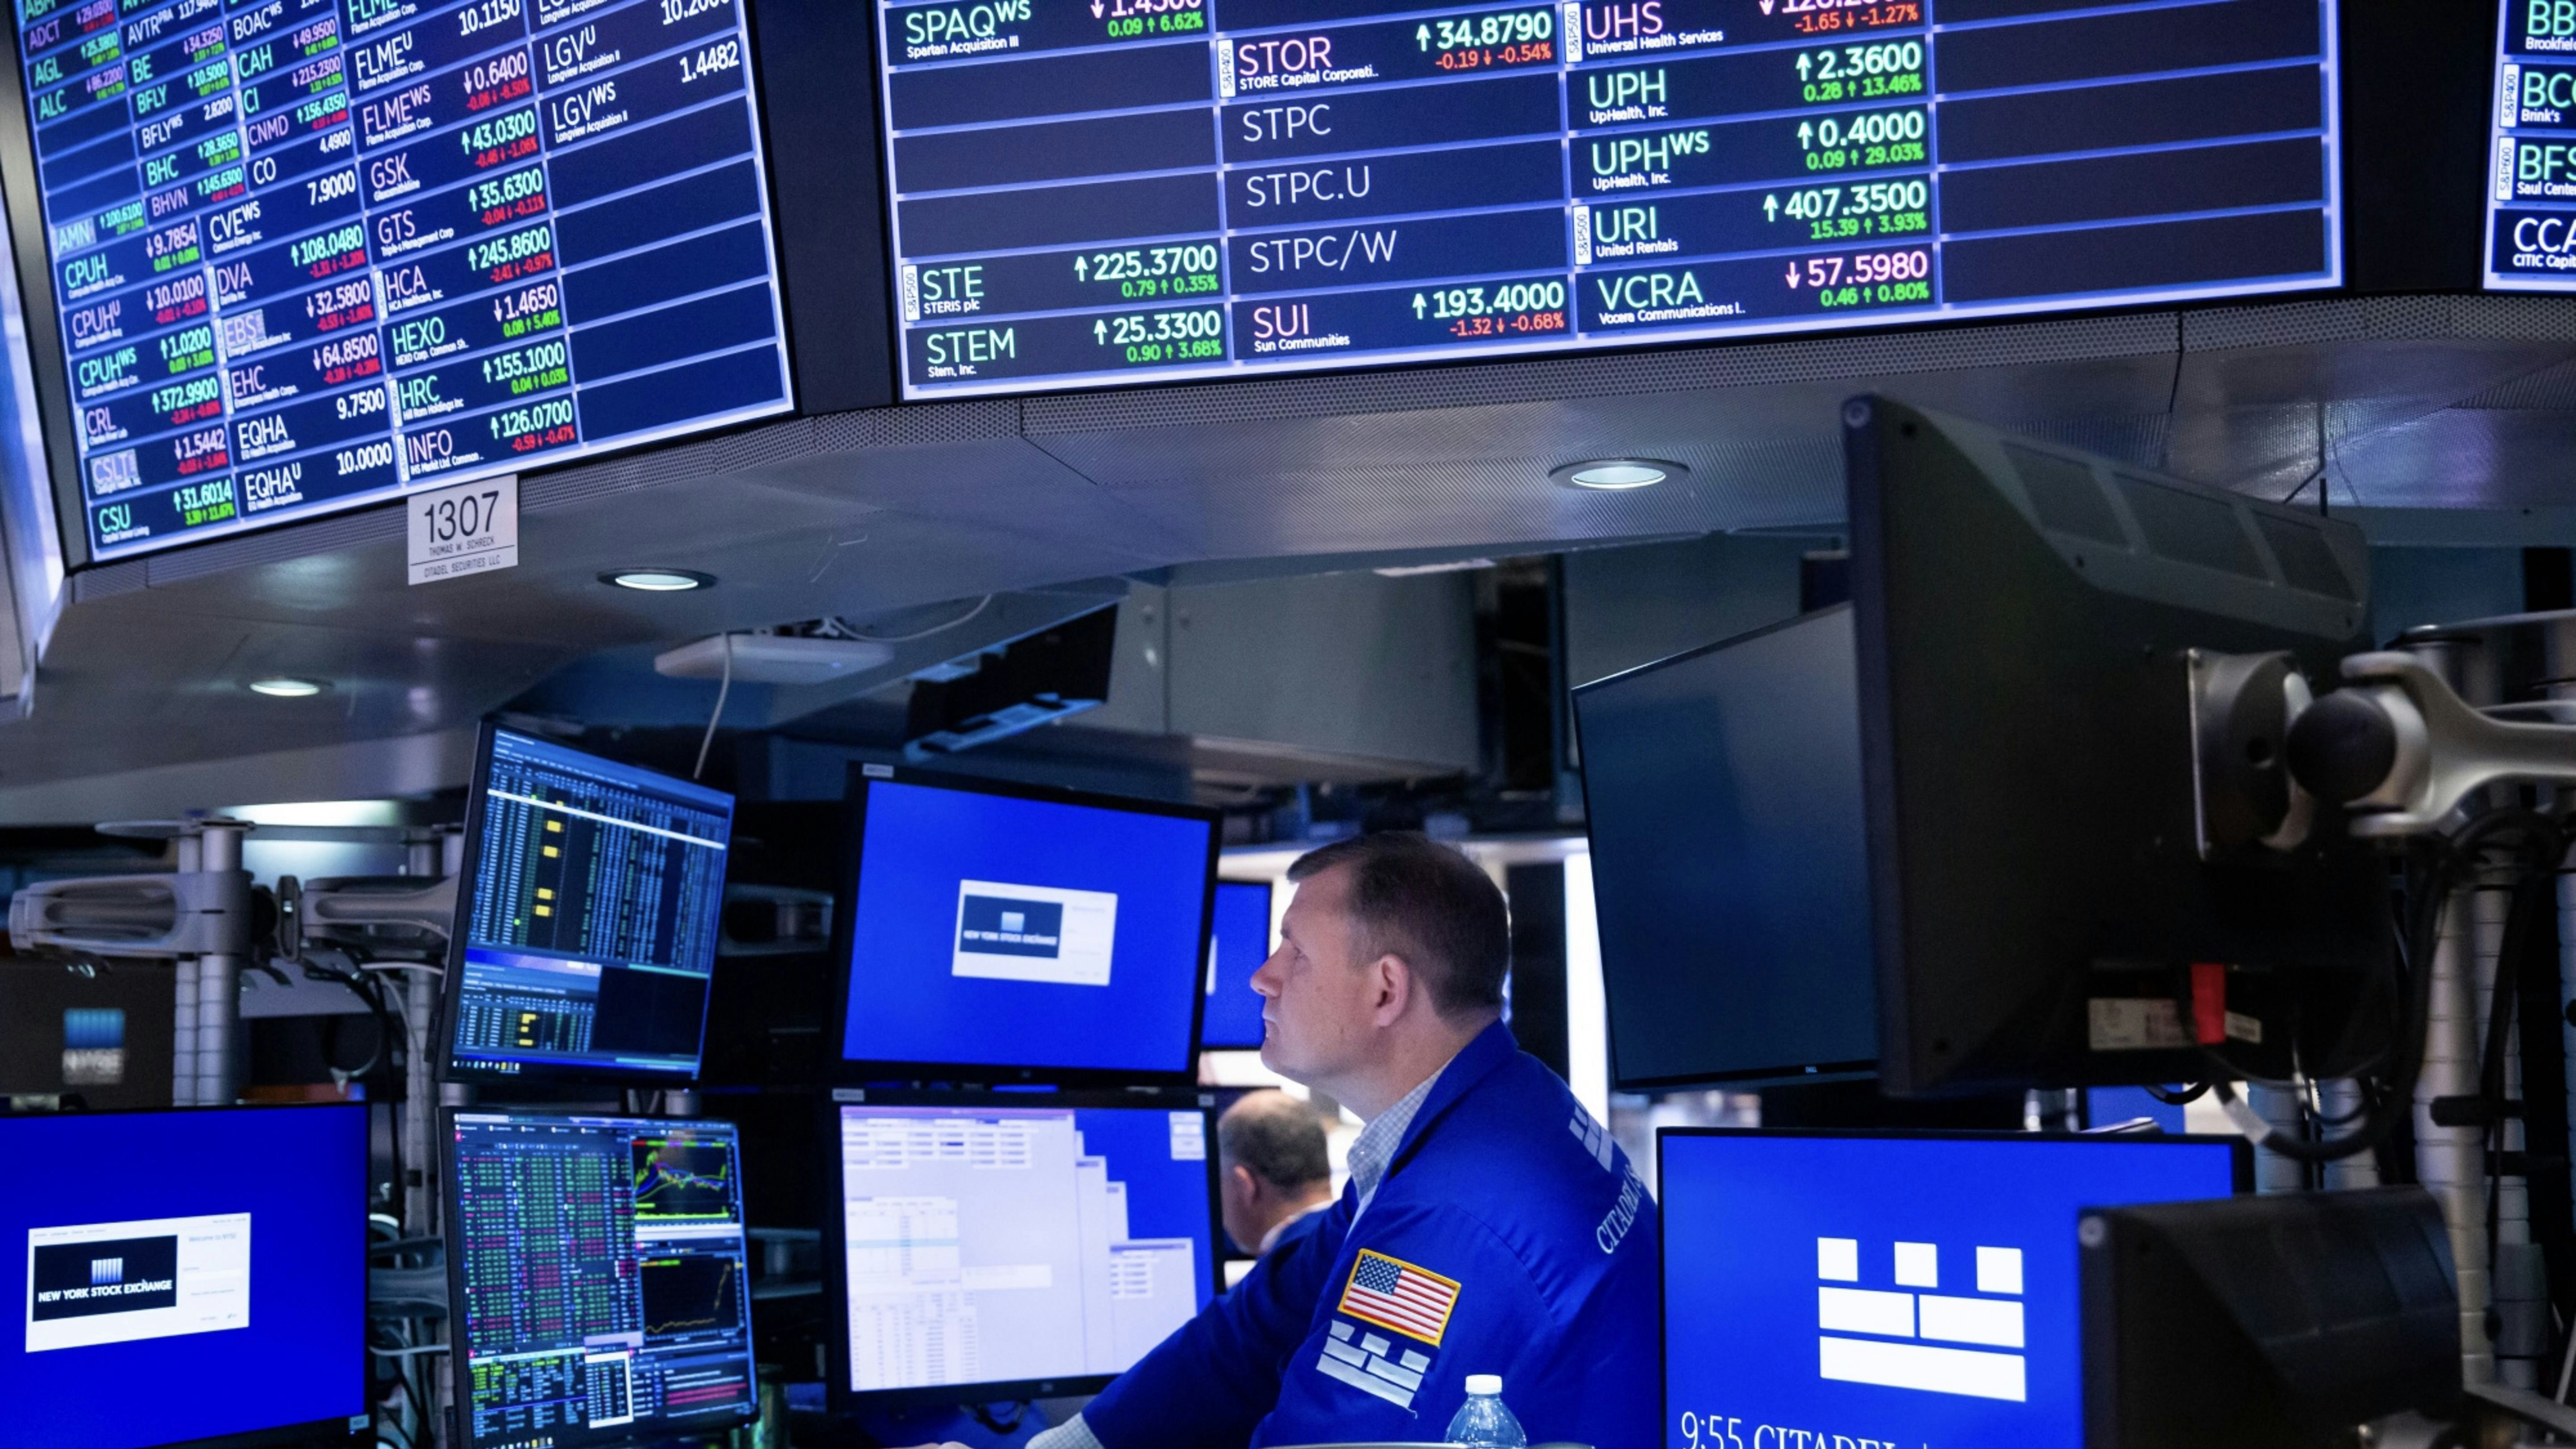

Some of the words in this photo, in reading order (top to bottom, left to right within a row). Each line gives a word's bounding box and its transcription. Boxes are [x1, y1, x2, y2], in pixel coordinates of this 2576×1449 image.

[458, 0, 520, 36] 10.1150
[1108, 20, 1143, 37] 0.09
[1160, 11, 1203, 32] 6.62%
[1436, 11, 1551, 50] 34.8790
[1585, 1, 1663, 40] UHS
[1795, 14, 1840, 33] -1.65
[1861, 4, 1919, 25] -1.27%
[907, 42, 947, 59] Spartan
[949, 37, 1007, 55] Acquisition
[1238, 37, 1333, 77] STOR
[1435, 50, 1479, 70] -0.19
[1497, 42, 1551, 63] -0.54%
[1586, 36, 1638, 56] Universal
[1640, 32, 1676, 51] Health
[1679, 30, 1724, 47] Services
[35, 56, 63, 87] AGL
[131, 54, 153, 84] BE
[238, 43, 273, 78] CAH
[474, 51, 527, 90] 0.6400
[680, 41, 740, 83] 1.4482
[1817, 42, 1922, 81] 2.3600
[1240, 74, 1278, 90] STORE
[1281, 70, 1319, 88] Capital
[1589, 68, 1667, 110] UPH
[1804, 81, 1843, 102] 0.28
[1862, 73, 1922, 97] 13.46%
[2523, 72, 2576, 108] BC
[39, 89, 67, 120] ALC
[136, 84, 167, 114] BFLY
[243, 87, 259, 113] CI
[1590, 106, 1646, 125] UpHealth,
[1648, 105, 1669, 119] Inc.
[2521, 108, 2561, 123] Brink's
[248, 114, 288, 146] CNMD
[472, 110, 535, 149] 43.0300
[1242, 104, 1332, 143] STPC
[1818, 111, 1924, 149] 0.4000
[319, 129, 351, 155] 4.4900
[1807, 149, 1845, 170] 0.09
[1865, 142, 1924, 166] 29.03%
[253, 157, 276, 185] CO
[307, 170, 356, 205] 7.9000
[371, 153, 411, 188] GSK
[1246, 165, 1370, 207] STPC.U
[1593, 174, 1650, 192] UpHealth,
[1651, 172, 1671, 187] Inc.
[479, 168, 543, 208] 35.6300
[1784, 180, 1926, 220] 407.3500
[2517, 181, 2542, 195] Saul
[154, 222, 198, 255] 9.7854
[378, 210, 415, 244] GTS
[1595, 206, 1658, 244] URI
[1810, 218, 1859, 240] 15.39
[1878, 212, 1927, 234] 3.93%
[301, 225, 363, 265] 108.0480
[479, 226, 550, 268] 245.8600
[1250, 229, 1397, 272] STPC/W
[1596, 242, 1634, 259] United
[1636, 239, 1678, 255] Rentals
[2512, 254, 2544, 267] CITIC
[65, 253, 108, 288] CPUH
[217, 262, 253, 294] DVA
[1093, 244, 1218, 281] 225.3700
[1808, 250, 1928, 287] 57.5980
[315, 280, 370, 314] 32.5800
[385, 265, 427, 301] HCA
[923, 265, 984, 301] STE
[1122, 279, 1157, 298] 0.79
[1173, 274, 1218, 294] 0.35%
[1597, 272, 1703, 310] VCRA
[1821, 286, 1858, 306] 0.46
[1878, 281, 1930, 302] 0.80%
[504, 284, 558, 319] 1.4650
[924, 300, 962, 314] STERIS
[963, 297, 980, 312] plc
[1432, 282, 1565, 319] 193.4000
[1599, 309, 1635, 326] Vocera
[1637, 302, 1733, 322] Communications
[392, 316, 445, 354] HEXO
[1112, 310, 1221, 344] 25.3300
[1254, 303, 1309, 338] SUI
[1450, 318, 1491, 337] -1.32
[1511, 312, 1565, 332] -0.68%
[323, 333, 377, 368] 64.8500
[927, 327, 1016, 364] STEM
[1126, 344, 1161, 363] 0.90
[1178, 339, 1222, 357] 3.68%
[1254, 338, 1276, 352] Sun
[1279, 332, 1350, 351] Communities
[494, 341, 565, 381] 155.1000
[928, 364, 957, 378] Stem,
[959, 362, 977, 376] Inc.
[161, 377, 219, 412] 372.9900
[231, 365, 266, 397] EHC
[400, 375, 440, 409] HRC
[86, 406, 116, 435] CRL
[337, 388, 385, 420] 9.7500
[500, 399, 573, 438] 126.0700
[238, 415, 288, 449] EQHA
[408, 429, 453, 464] INFO
[336, 442, 392, 476] 10.0000
[183, 479, 233, 510] 31.6014
[99, 504, 131, 532] CSU
[424, 490, 499, 543] 1307
[424, 565, 448, 578] CITADEL
[451, 557, 486, 573] SECURITIES
[489, 555, 500, 565] LLC
[429, 544, 453, 557] THOMAS
[38, 1291, 60, 1302] NEW
[63, 1288, 89, 1300] YORK
[91, 1284, 122, 1297] STOCK
[124, 1279, 173, 1294] EXCHANGE
